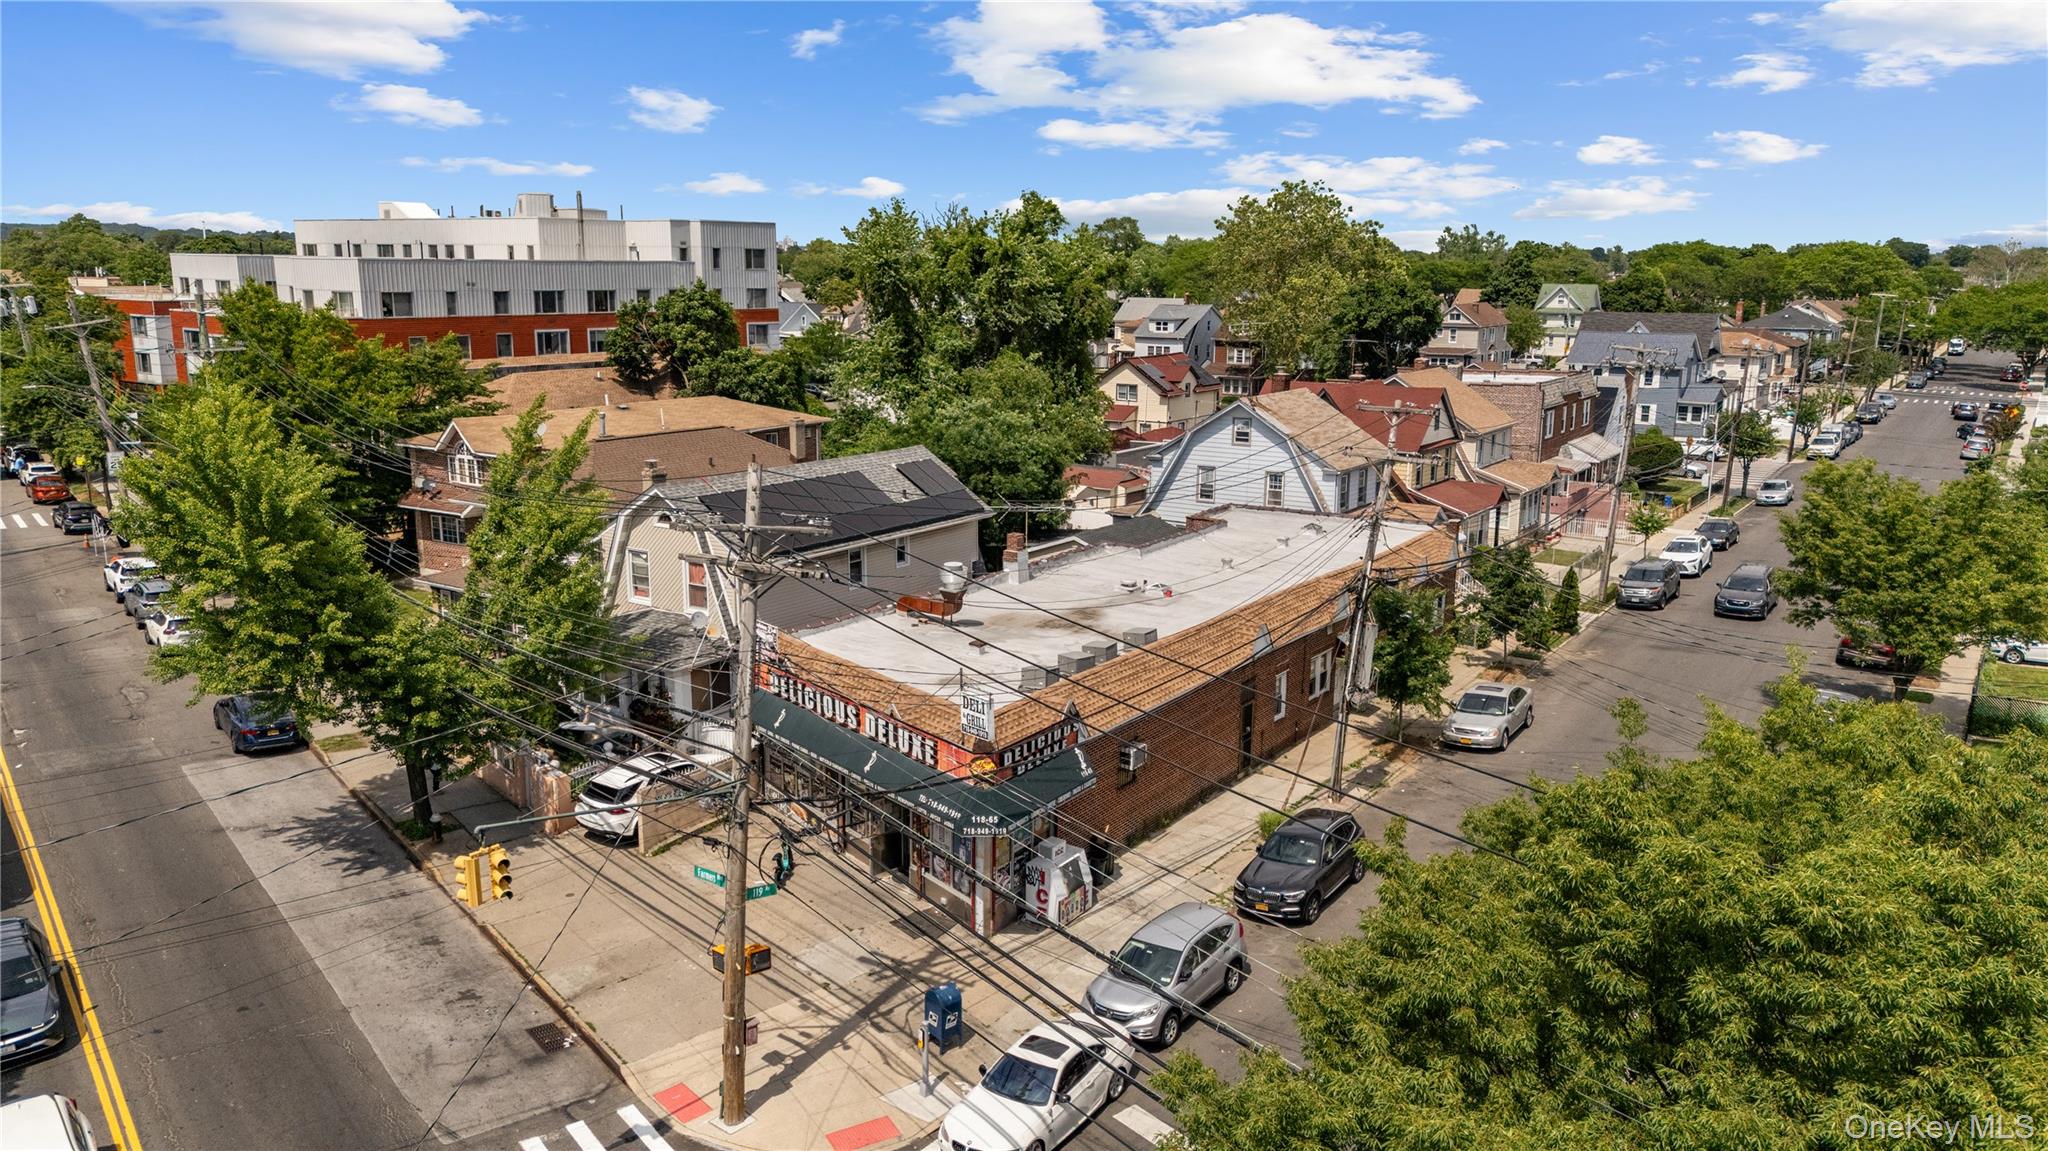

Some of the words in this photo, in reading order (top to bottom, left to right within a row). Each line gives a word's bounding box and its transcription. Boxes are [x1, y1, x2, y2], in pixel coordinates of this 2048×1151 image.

[962, 695, 986, 716] DELI
[770, 672, 858, 729] DELICIOUS
[865, 712, 937, 766] DELUXE
[966, 712, 987, 731] GRILL
[1003, 722, 1080, 767] DELICIOUS
[971, 815, 999, 824] 118-65
[697, 867, 717, 883] Farmers
[752, 887, 764, 897] 119
